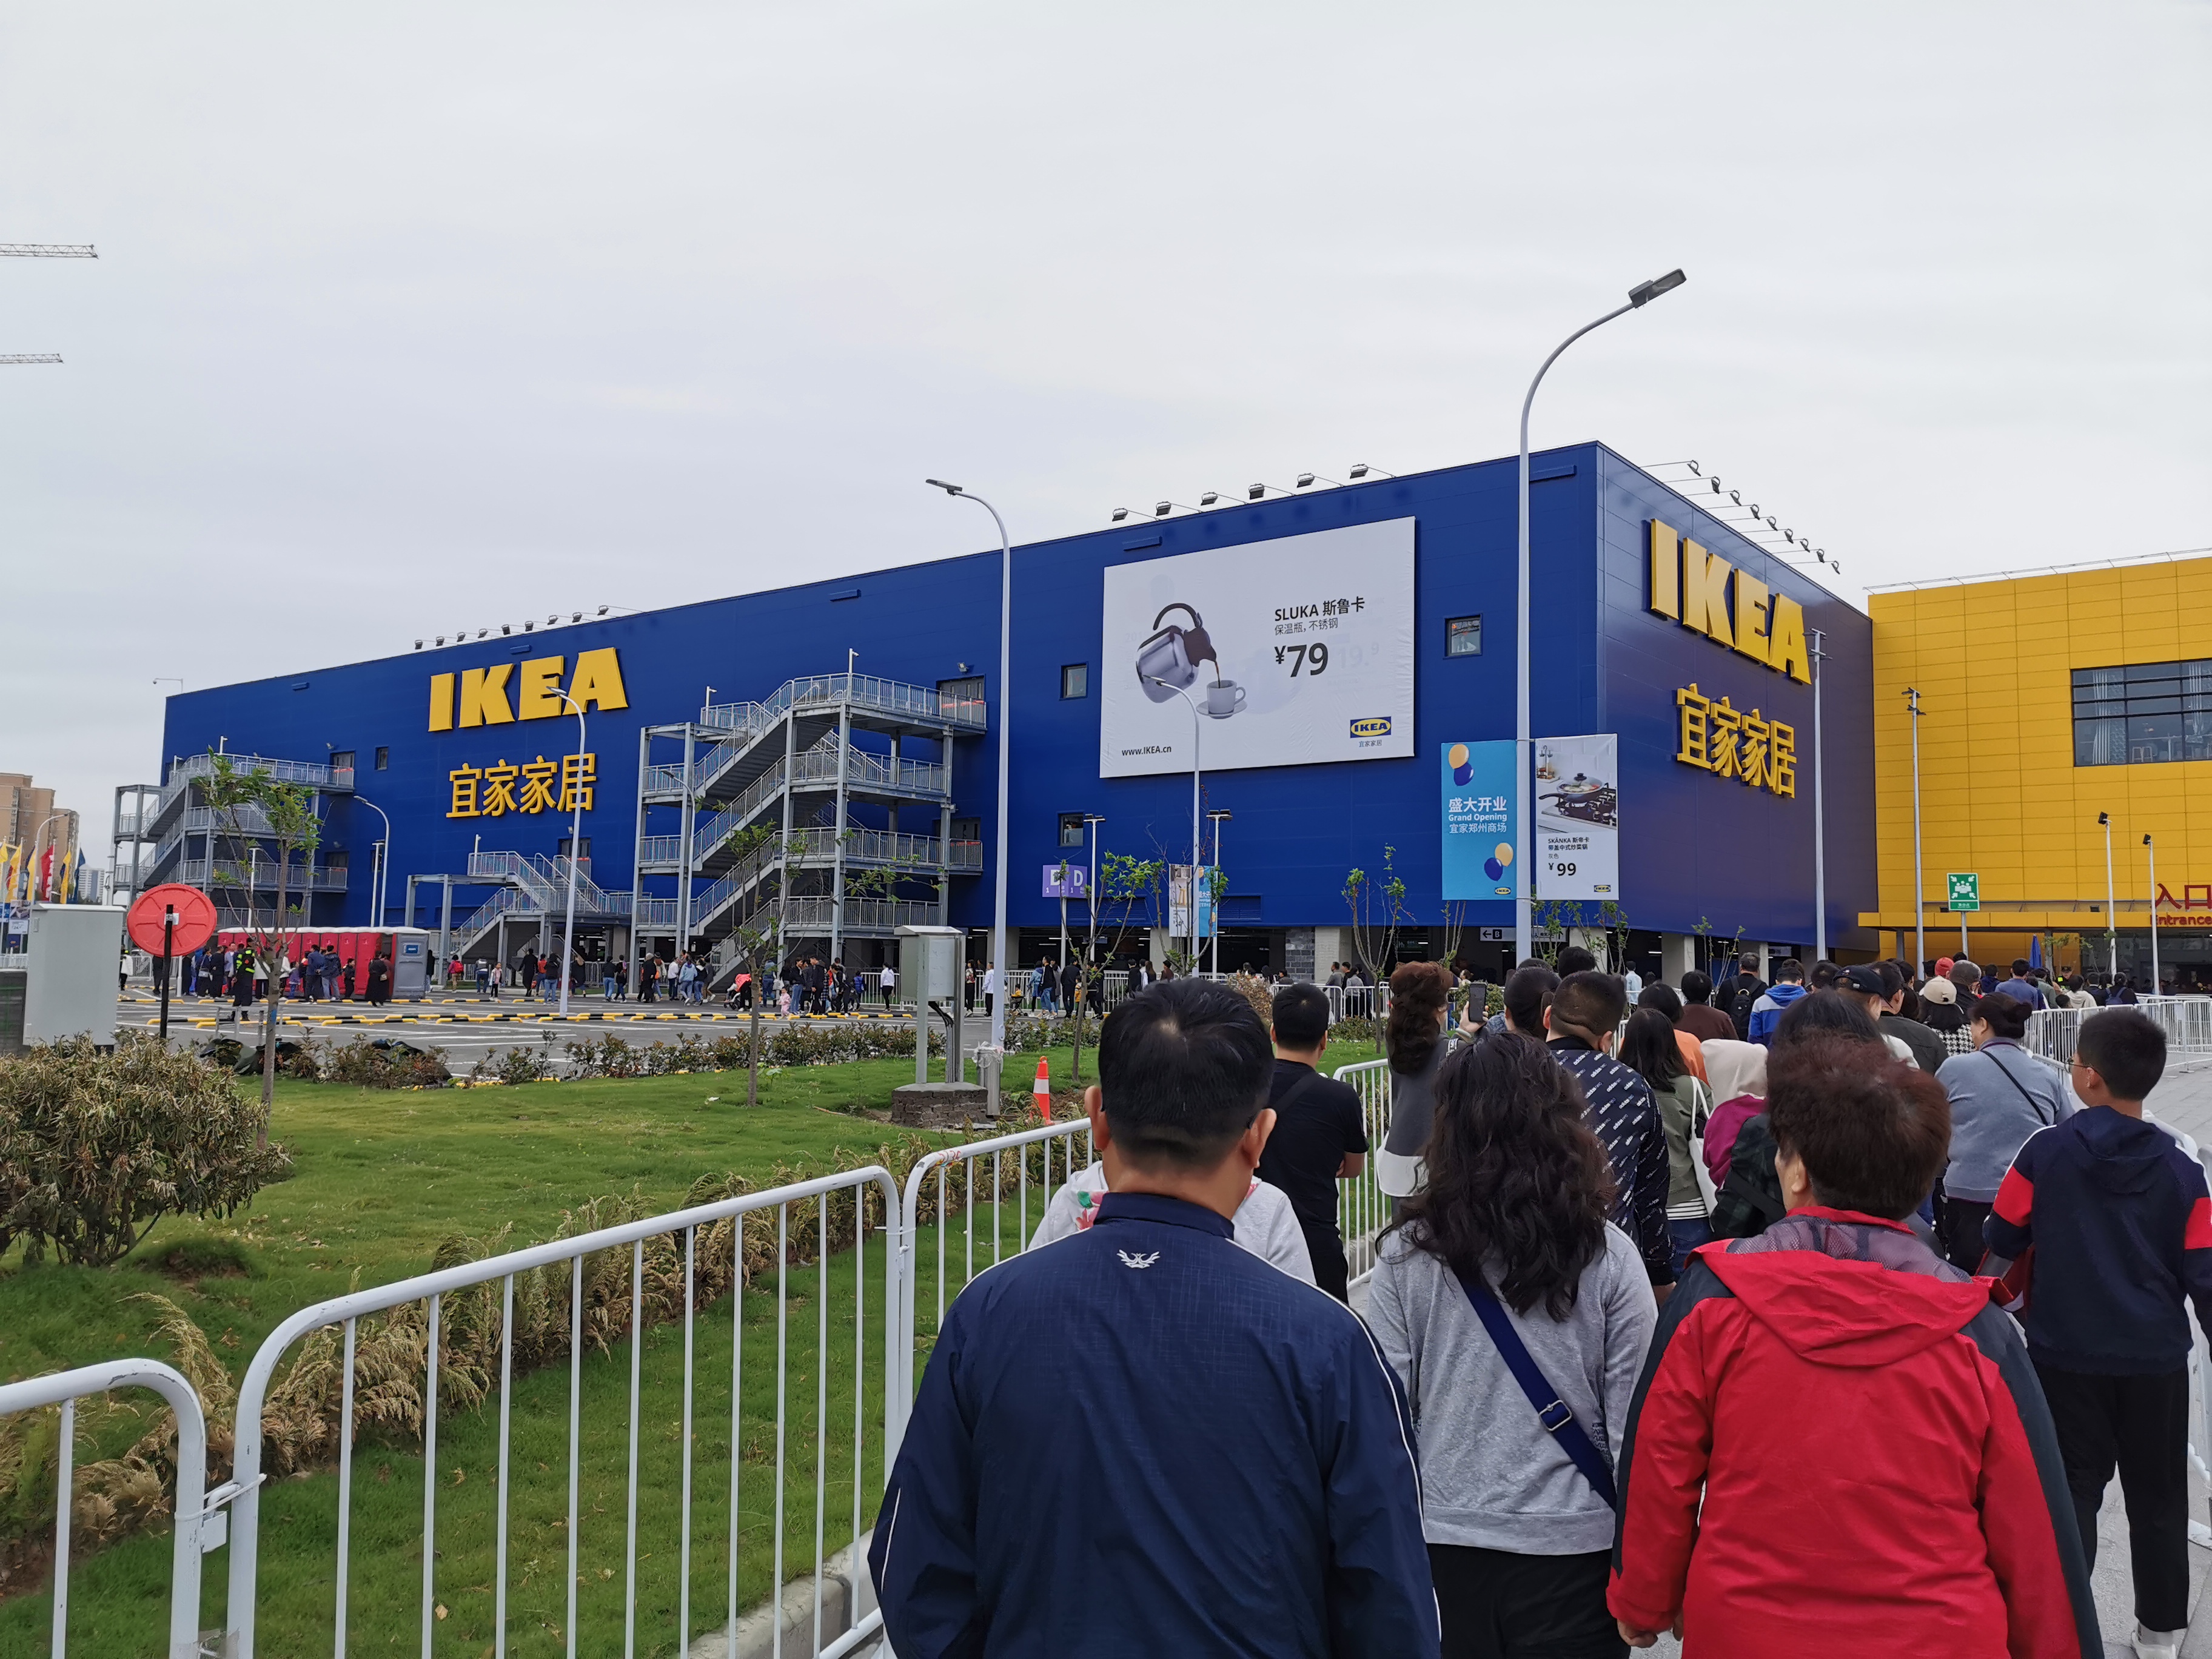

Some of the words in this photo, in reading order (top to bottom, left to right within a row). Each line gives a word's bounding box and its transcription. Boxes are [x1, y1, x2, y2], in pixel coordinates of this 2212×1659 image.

[1275, 604, 1319, 622] SLUKA
[1322, 596, 1366, 617] 斯鲁卡
[1651, 518, 1812, 685] IKEA
[428, 646, 629, 732] IKEA
[1354, 722, 1388, 732] IKEA
[1121, 745, 1172, 756] www.IKEA.cn
[1676, 683, 1797, 799] 宜家家居
[446, 752, 597, 818] 宜家家居
[1448, 796, 1507, 813] 盛大开业
[1449, 822, 1507, 834] 宜家郑州商场
[1473, 813, 1507, 822] Opening
[1073, 870, 1084, 886] D
[2150, 883, 2211, 910] 入口
